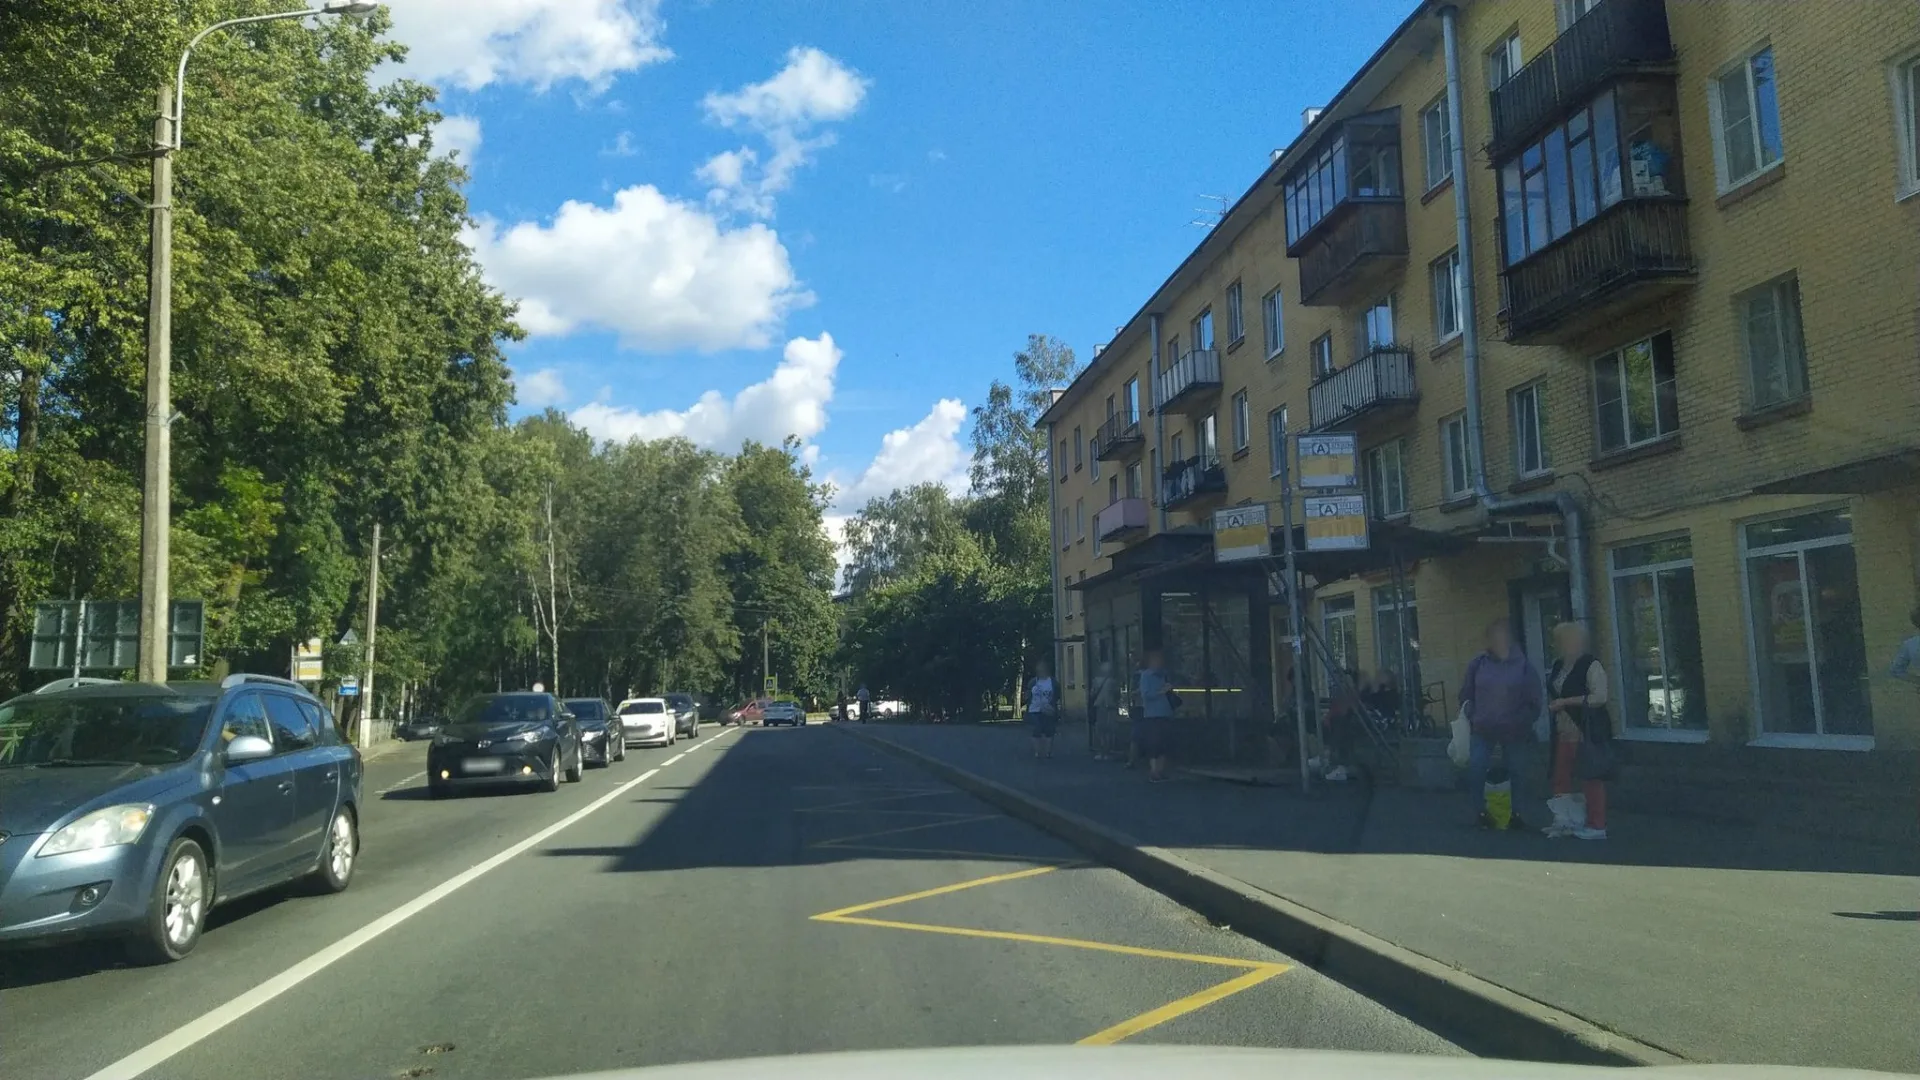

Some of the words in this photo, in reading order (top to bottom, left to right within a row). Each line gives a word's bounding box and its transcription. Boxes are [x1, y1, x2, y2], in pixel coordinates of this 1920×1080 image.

[1317, 444, 1325, 453] А
[1324, 505, 1333, 514] А
[1232, 516, 1240, 525] А
